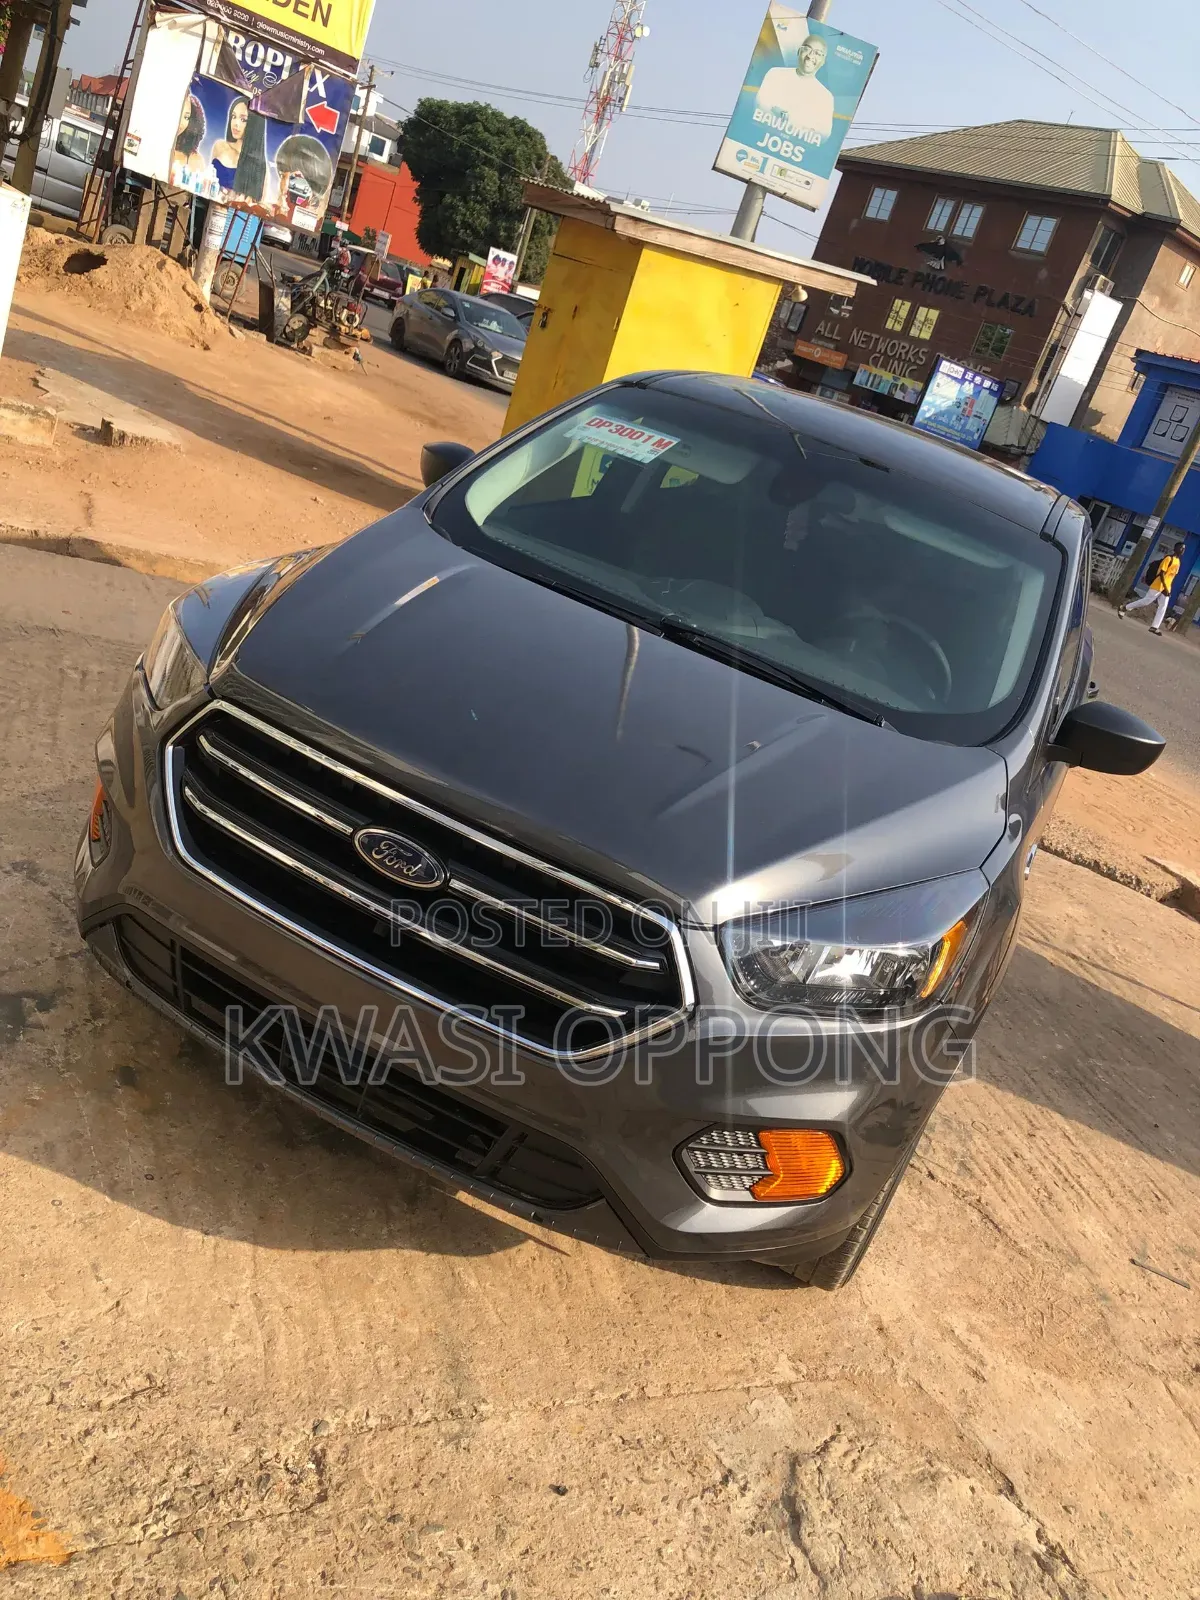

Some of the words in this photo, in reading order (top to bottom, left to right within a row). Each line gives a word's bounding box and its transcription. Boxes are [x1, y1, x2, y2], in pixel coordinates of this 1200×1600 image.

[752, 108, 822, 147] BAWUMIA
[756, 132, 806, 162] JOBS
[911, 270, 970, 300] PHONE
[973, 284, 1039, 318] PLAZA
[815, 320, 842, 340] ALL
[849, 327, 929, 365] NETWORKS
[869, 353, 918, 378] CLINIC
[371, 840, 422, 877] Ford
